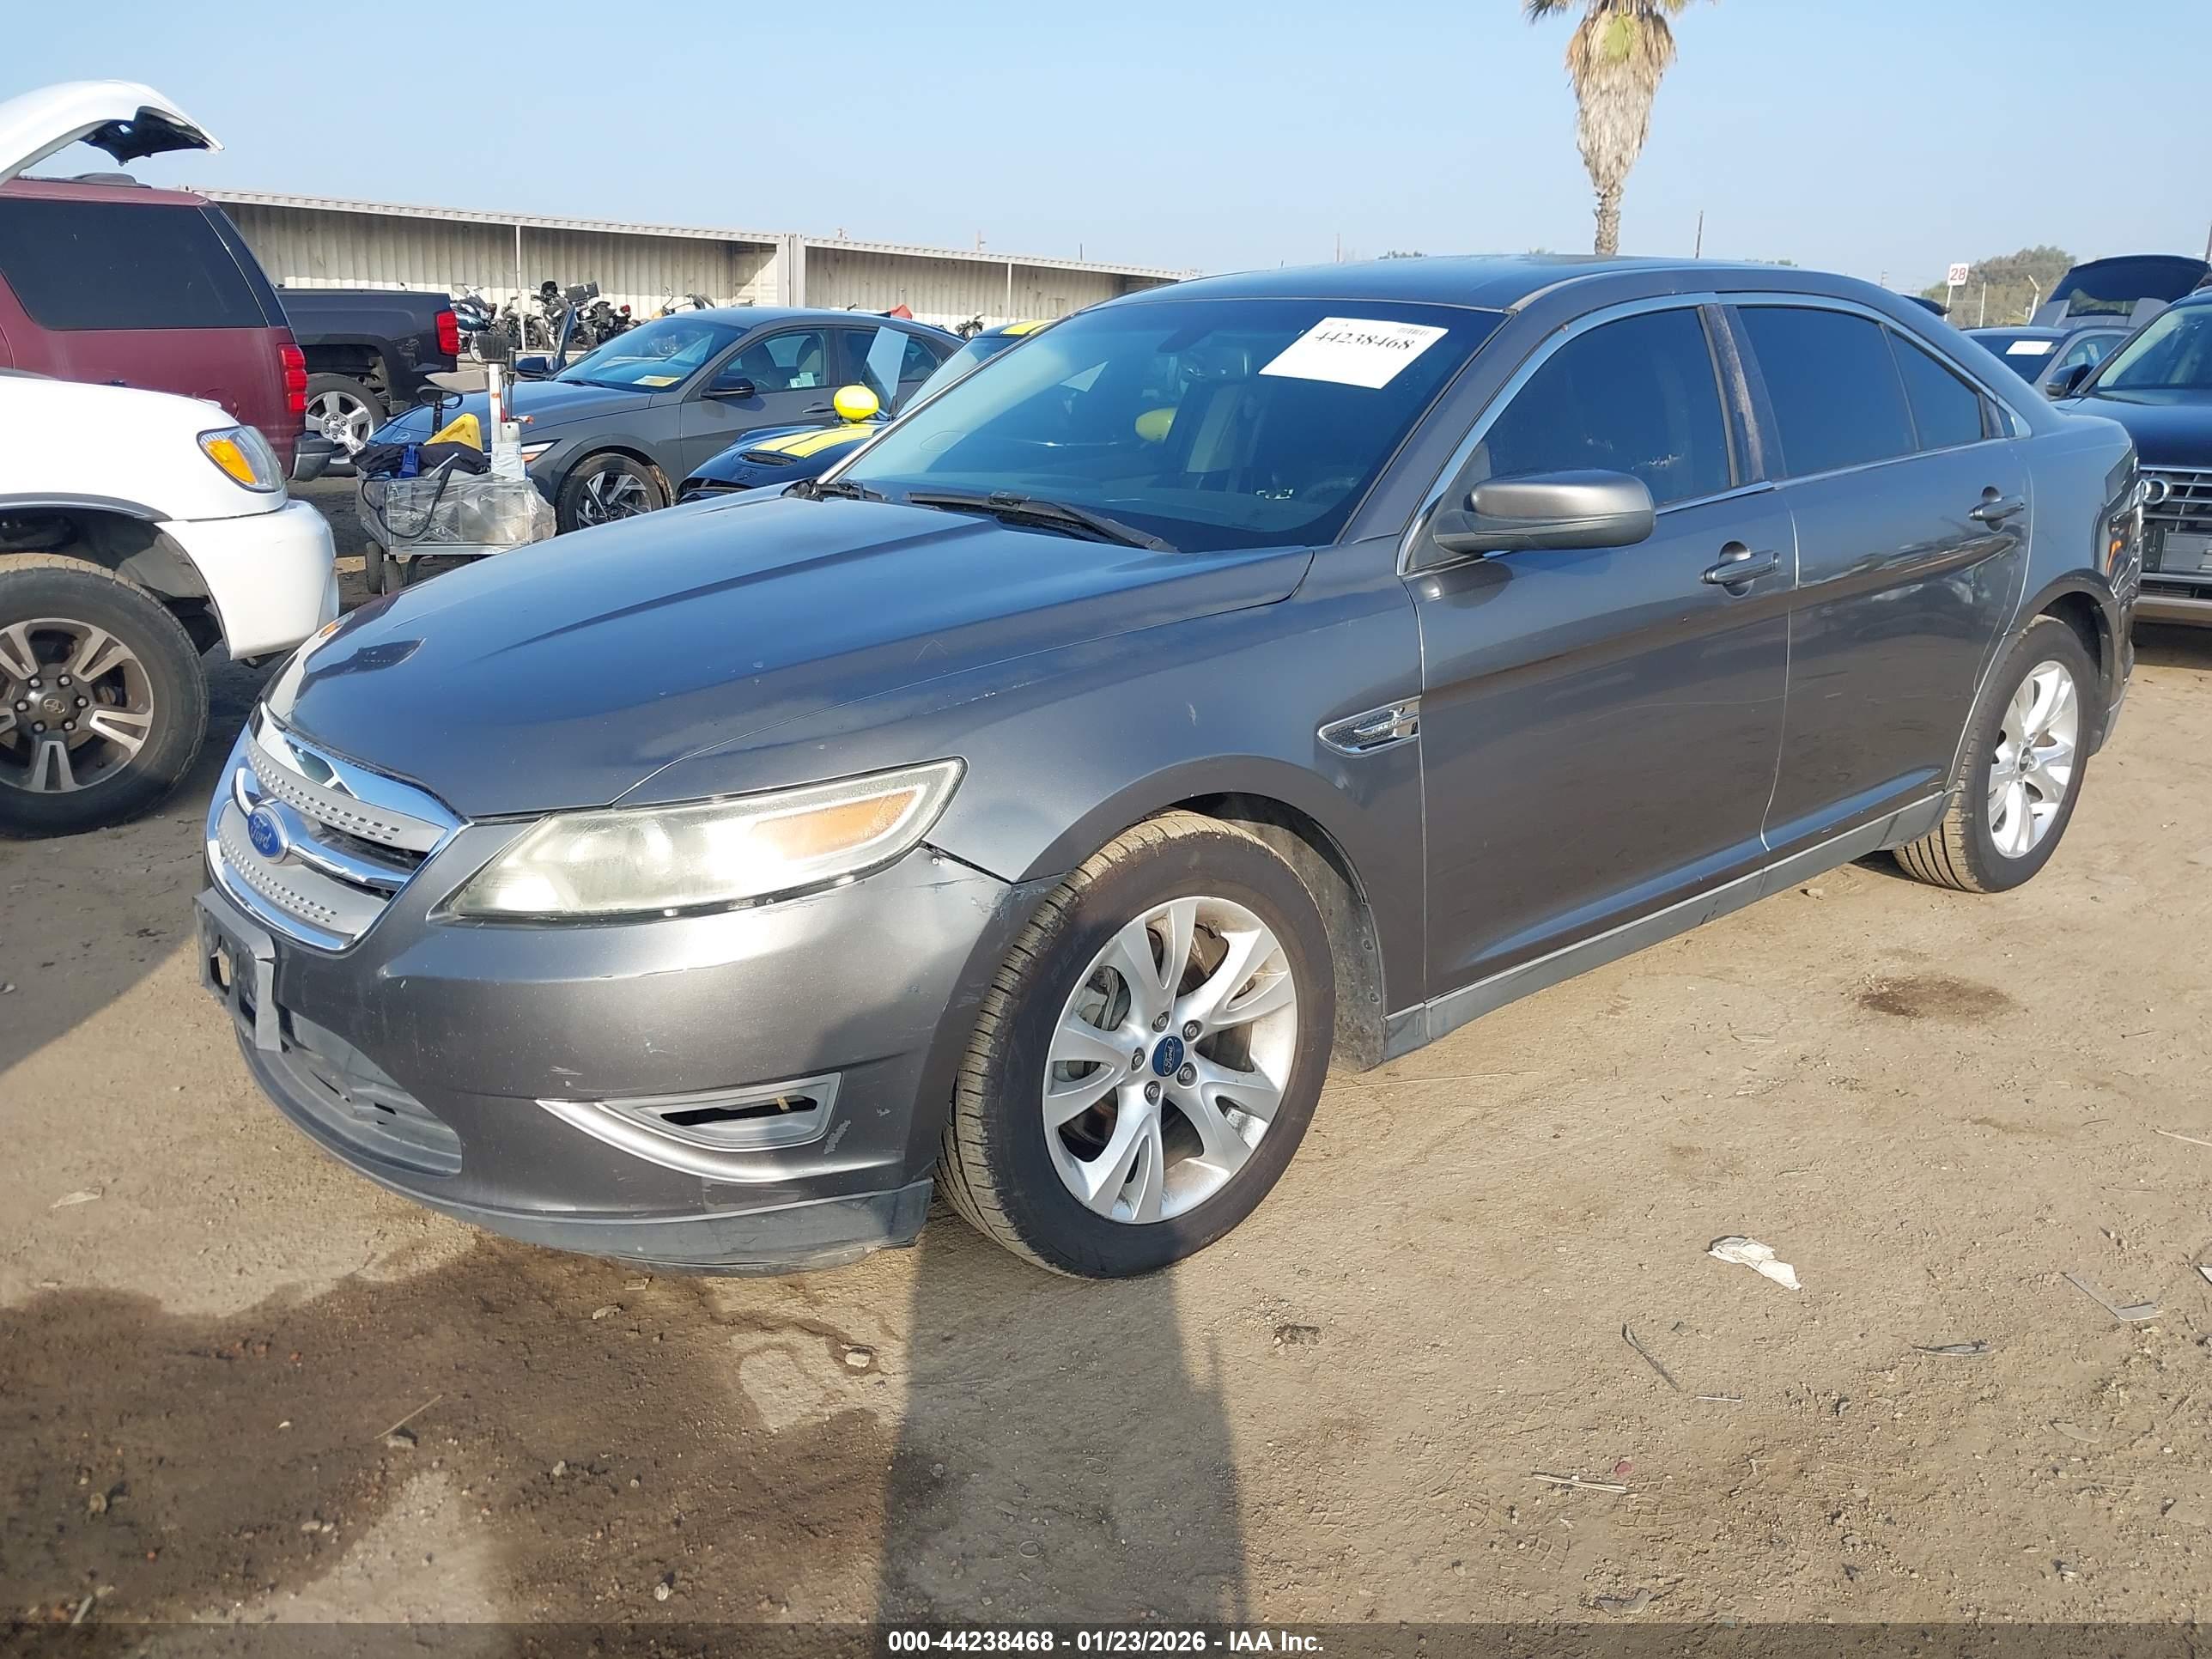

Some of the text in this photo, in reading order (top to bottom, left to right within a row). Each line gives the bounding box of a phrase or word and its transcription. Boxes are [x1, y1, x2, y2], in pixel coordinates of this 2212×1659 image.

[1950, 267, 1967, 281] 28
[1316, 331, 1415, 350] 44238468
[250, 815, 272, 850] Ford
